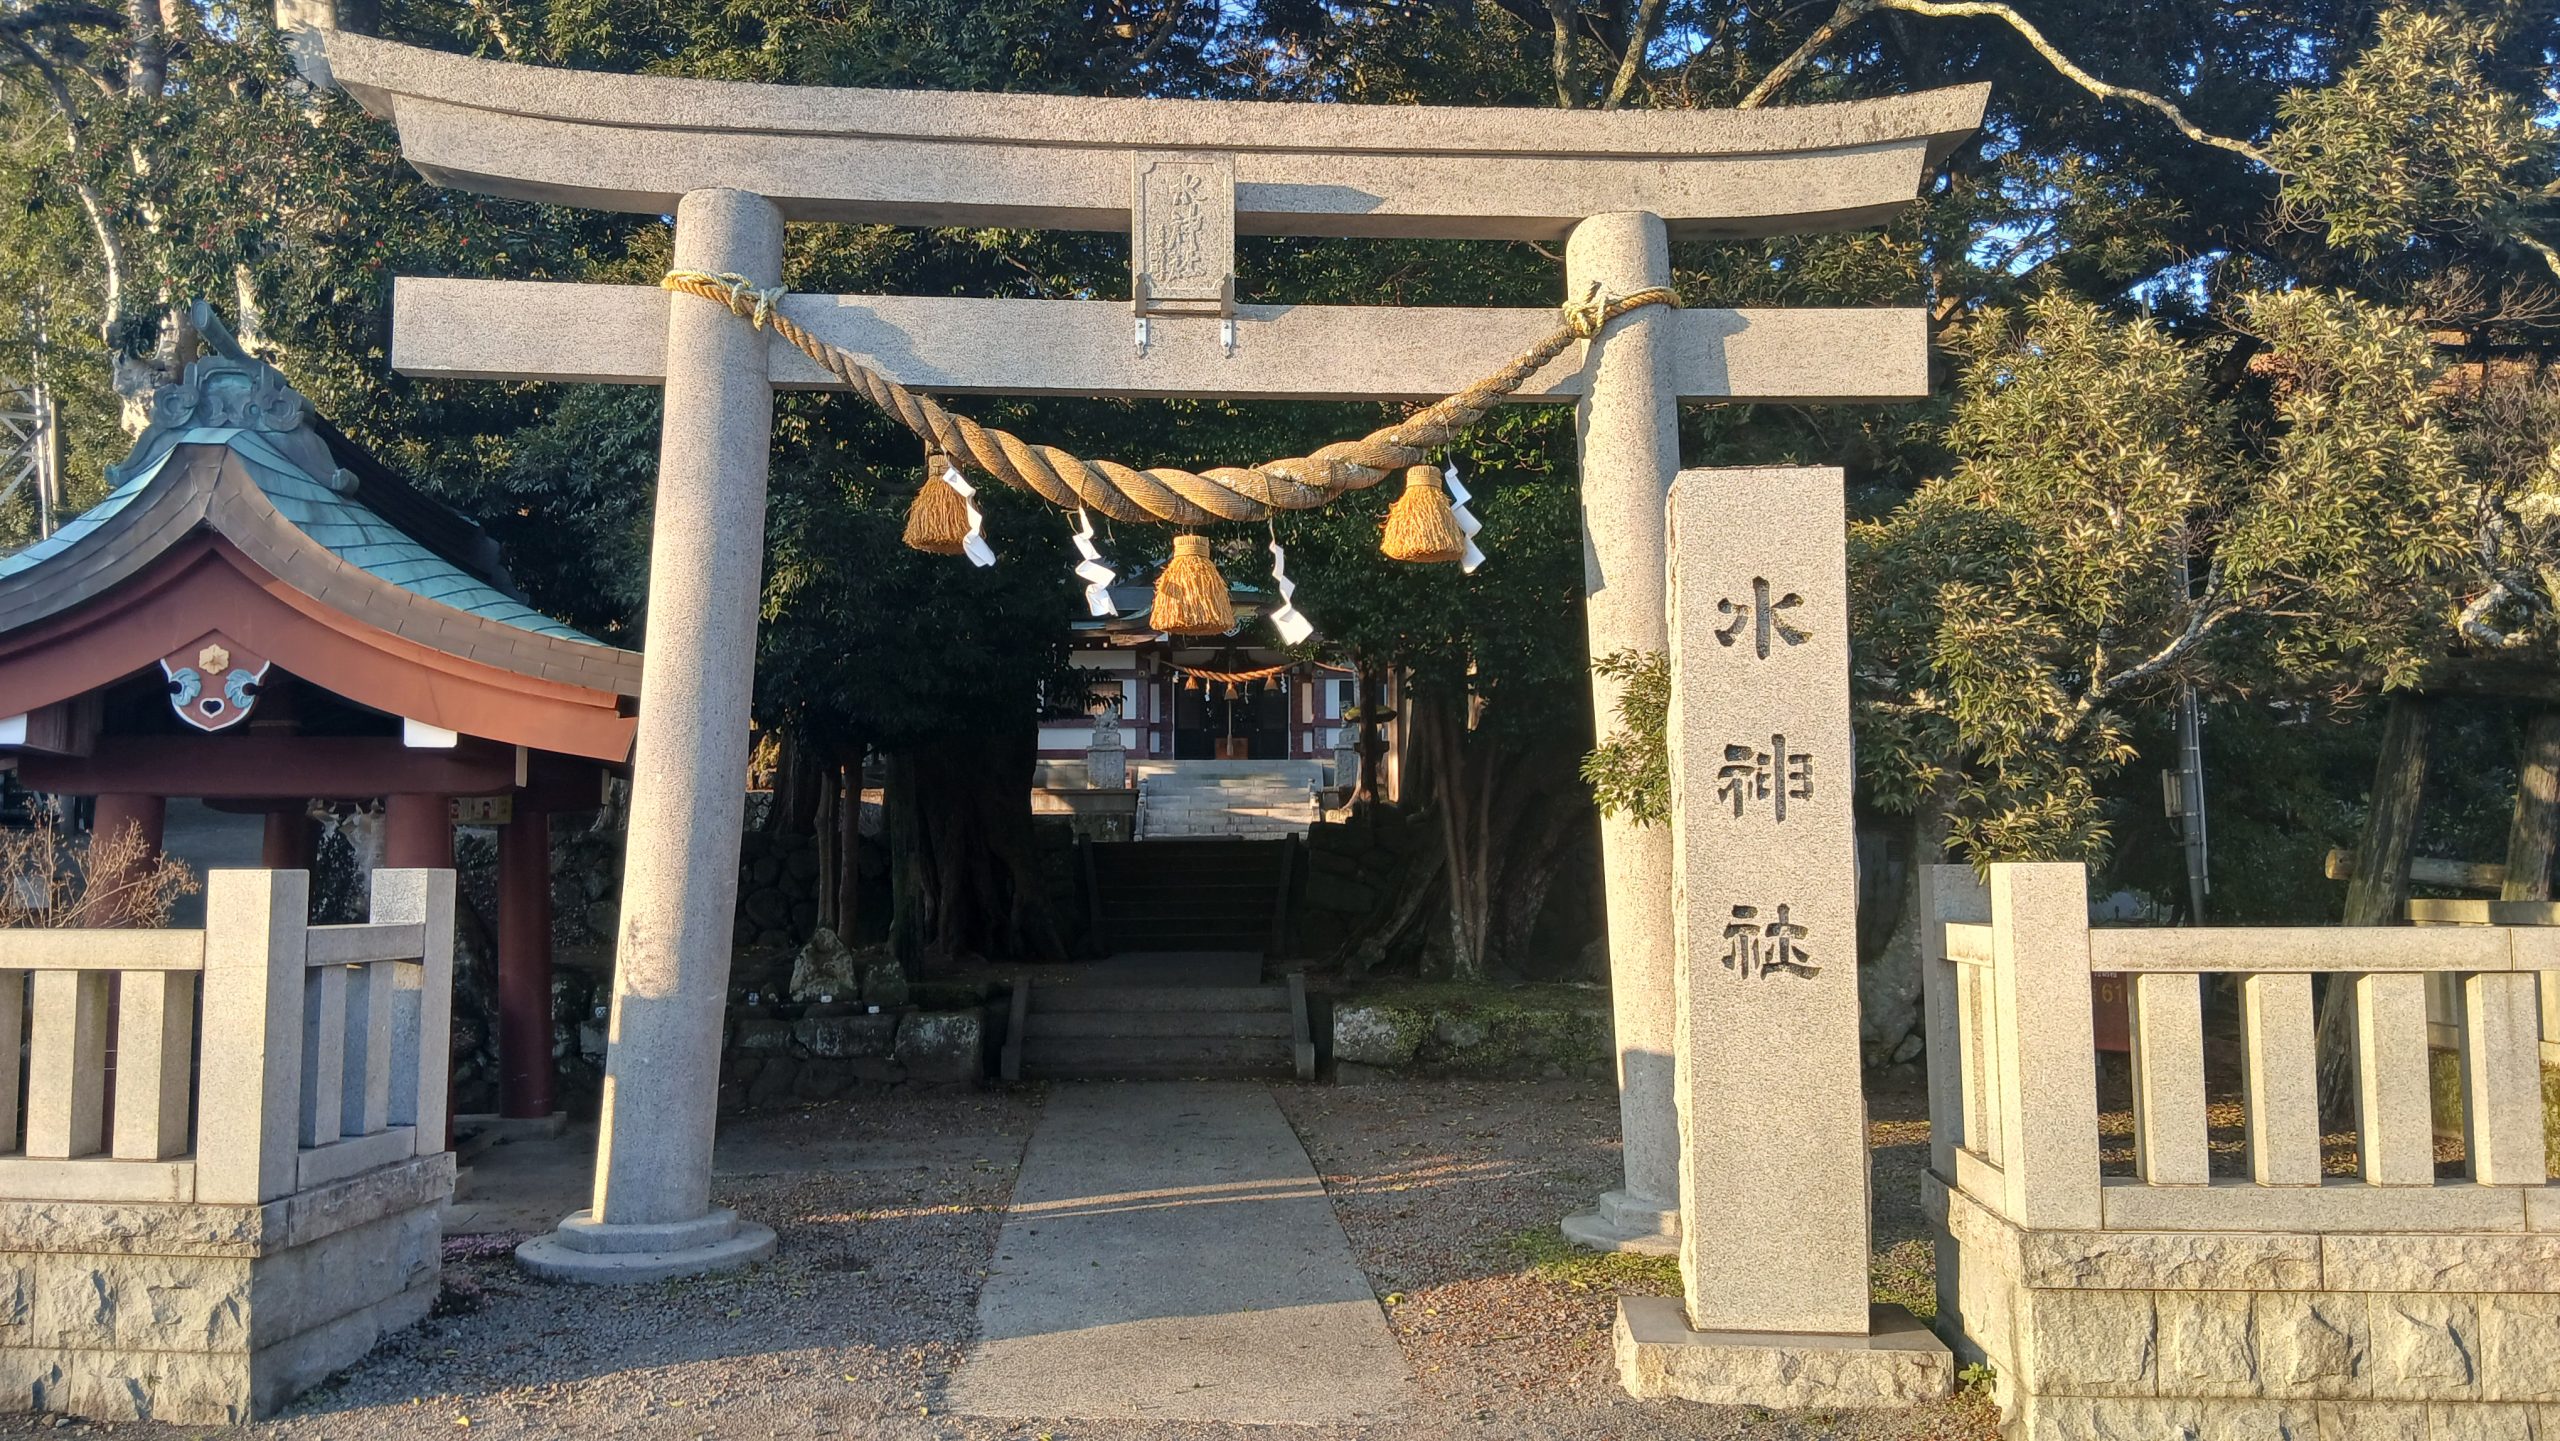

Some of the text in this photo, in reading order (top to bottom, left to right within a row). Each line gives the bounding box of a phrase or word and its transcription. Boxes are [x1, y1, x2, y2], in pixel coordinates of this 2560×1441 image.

[1168, 171, 1209, 284] 水神社
[1714, 575, 1823, 982] 水神社
